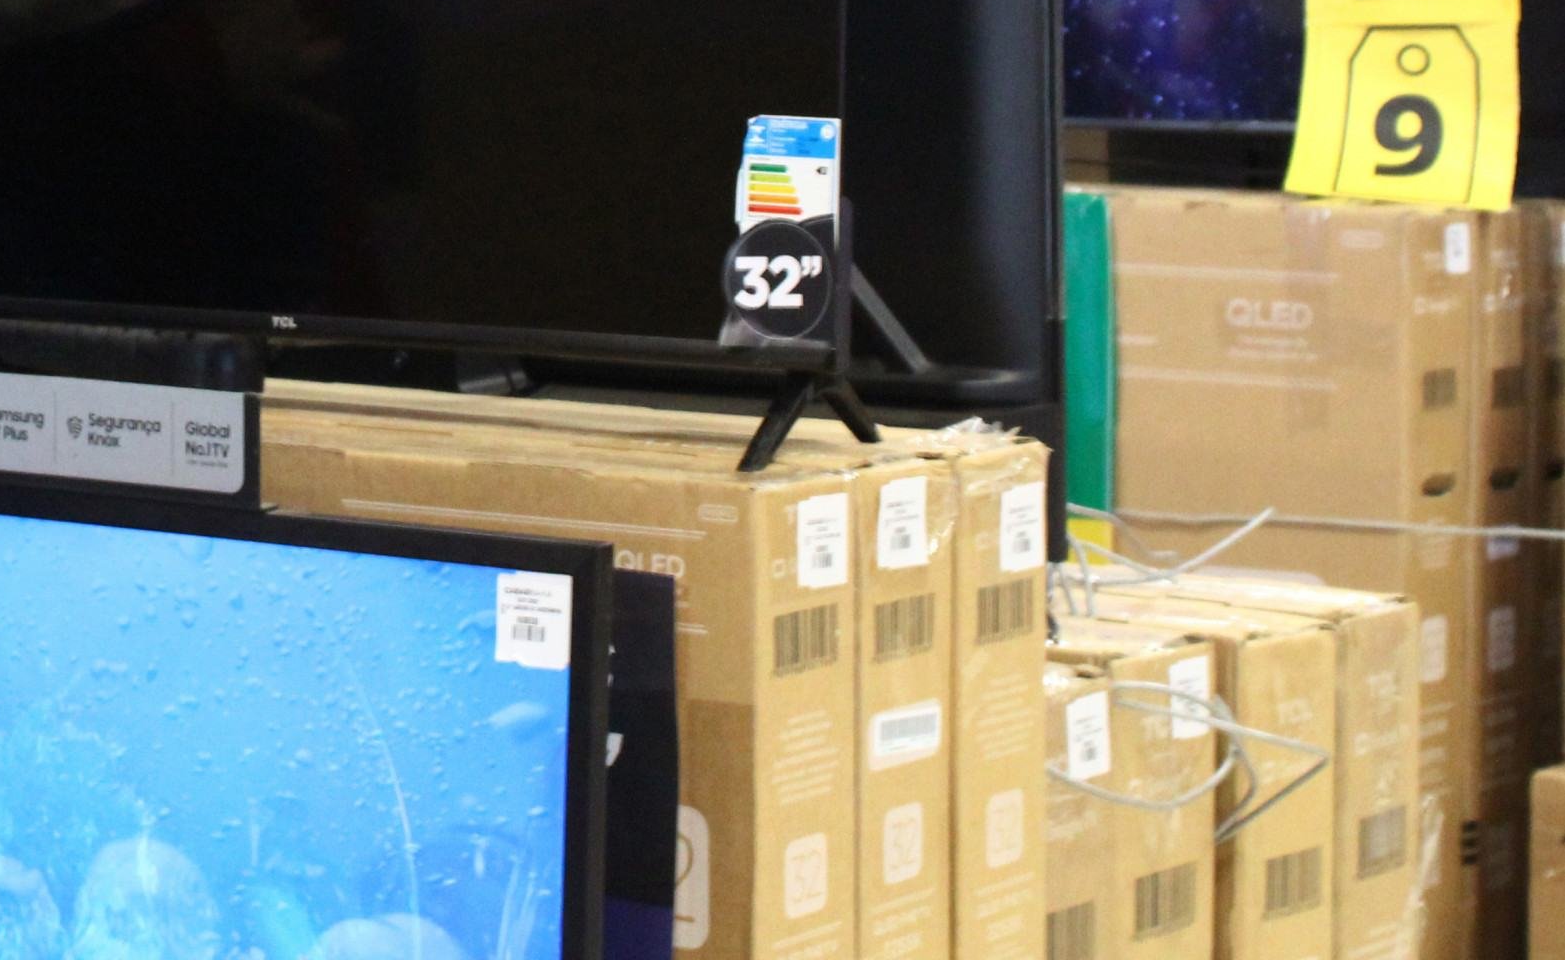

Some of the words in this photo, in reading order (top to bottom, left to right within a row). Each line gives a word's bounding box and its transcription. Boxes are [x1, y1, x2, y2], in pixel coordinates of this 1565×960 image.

[1373, 94, 1444, 177] 9
[271, 315, 298, 330] TCL
[1225, 297, 1314, 330] QLED
[2, 426, 29, 441] Plus
[88, 413, 162, 437] Segurança
[185, 420, 231, 439] Global
[87, 432, 121, 448] Knox
